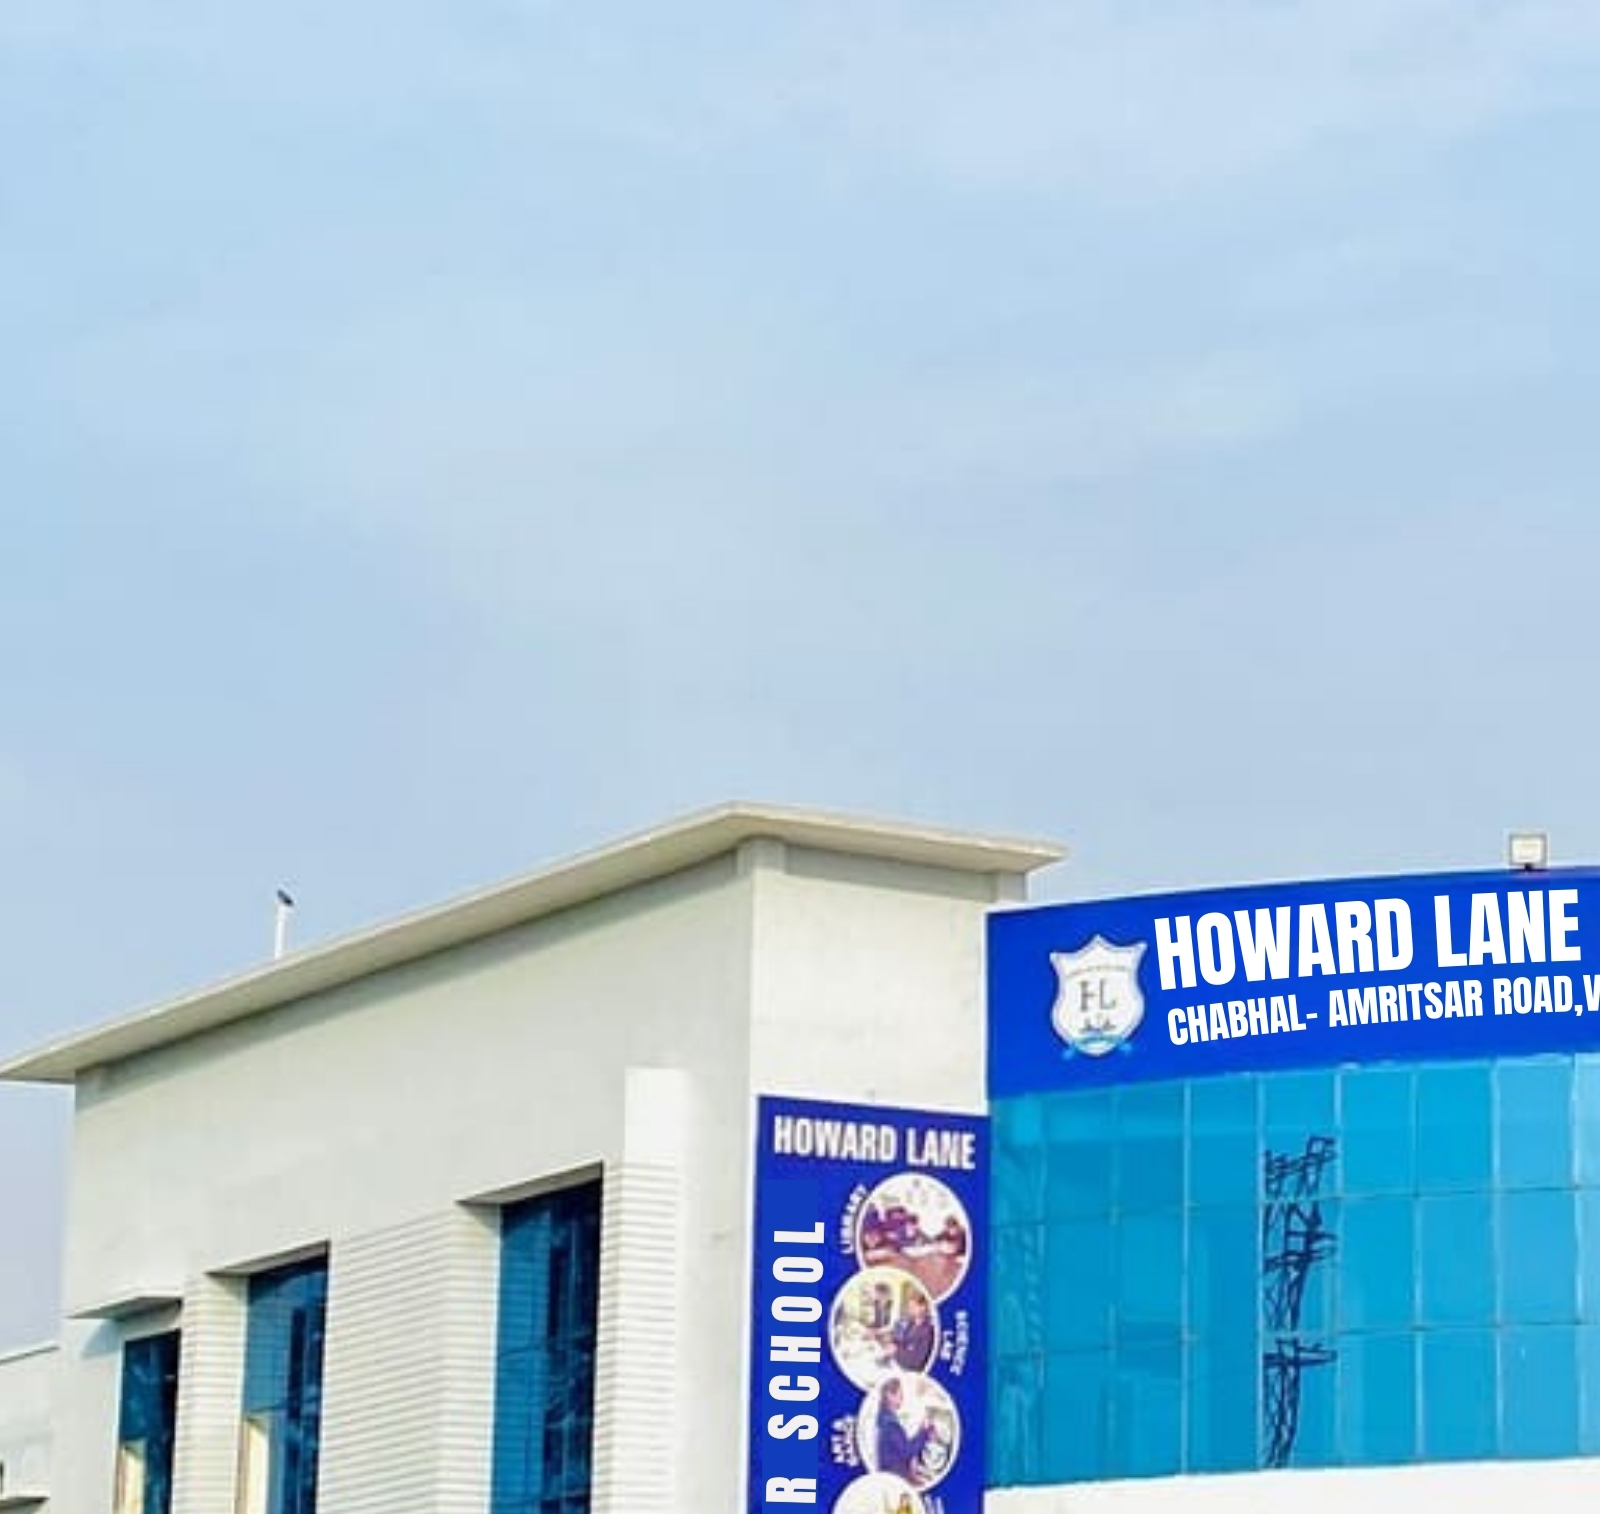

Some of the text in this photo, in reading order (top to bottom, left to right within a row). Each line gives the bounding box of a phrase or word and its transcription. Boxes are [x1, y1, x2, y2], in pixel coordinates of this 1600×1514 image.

[1155, 899, 1413, 991] HOWARD
[1435, 890, 1580, 968] LANE
[1168, 995, 1318, 1045] CHABHAL-
[1329, 979, 1483, 1027] AMRITSAR
[774, 1115, 976, 1169] HOWARD LANE
[768, 1221, 824, 1440] SCHOOL
